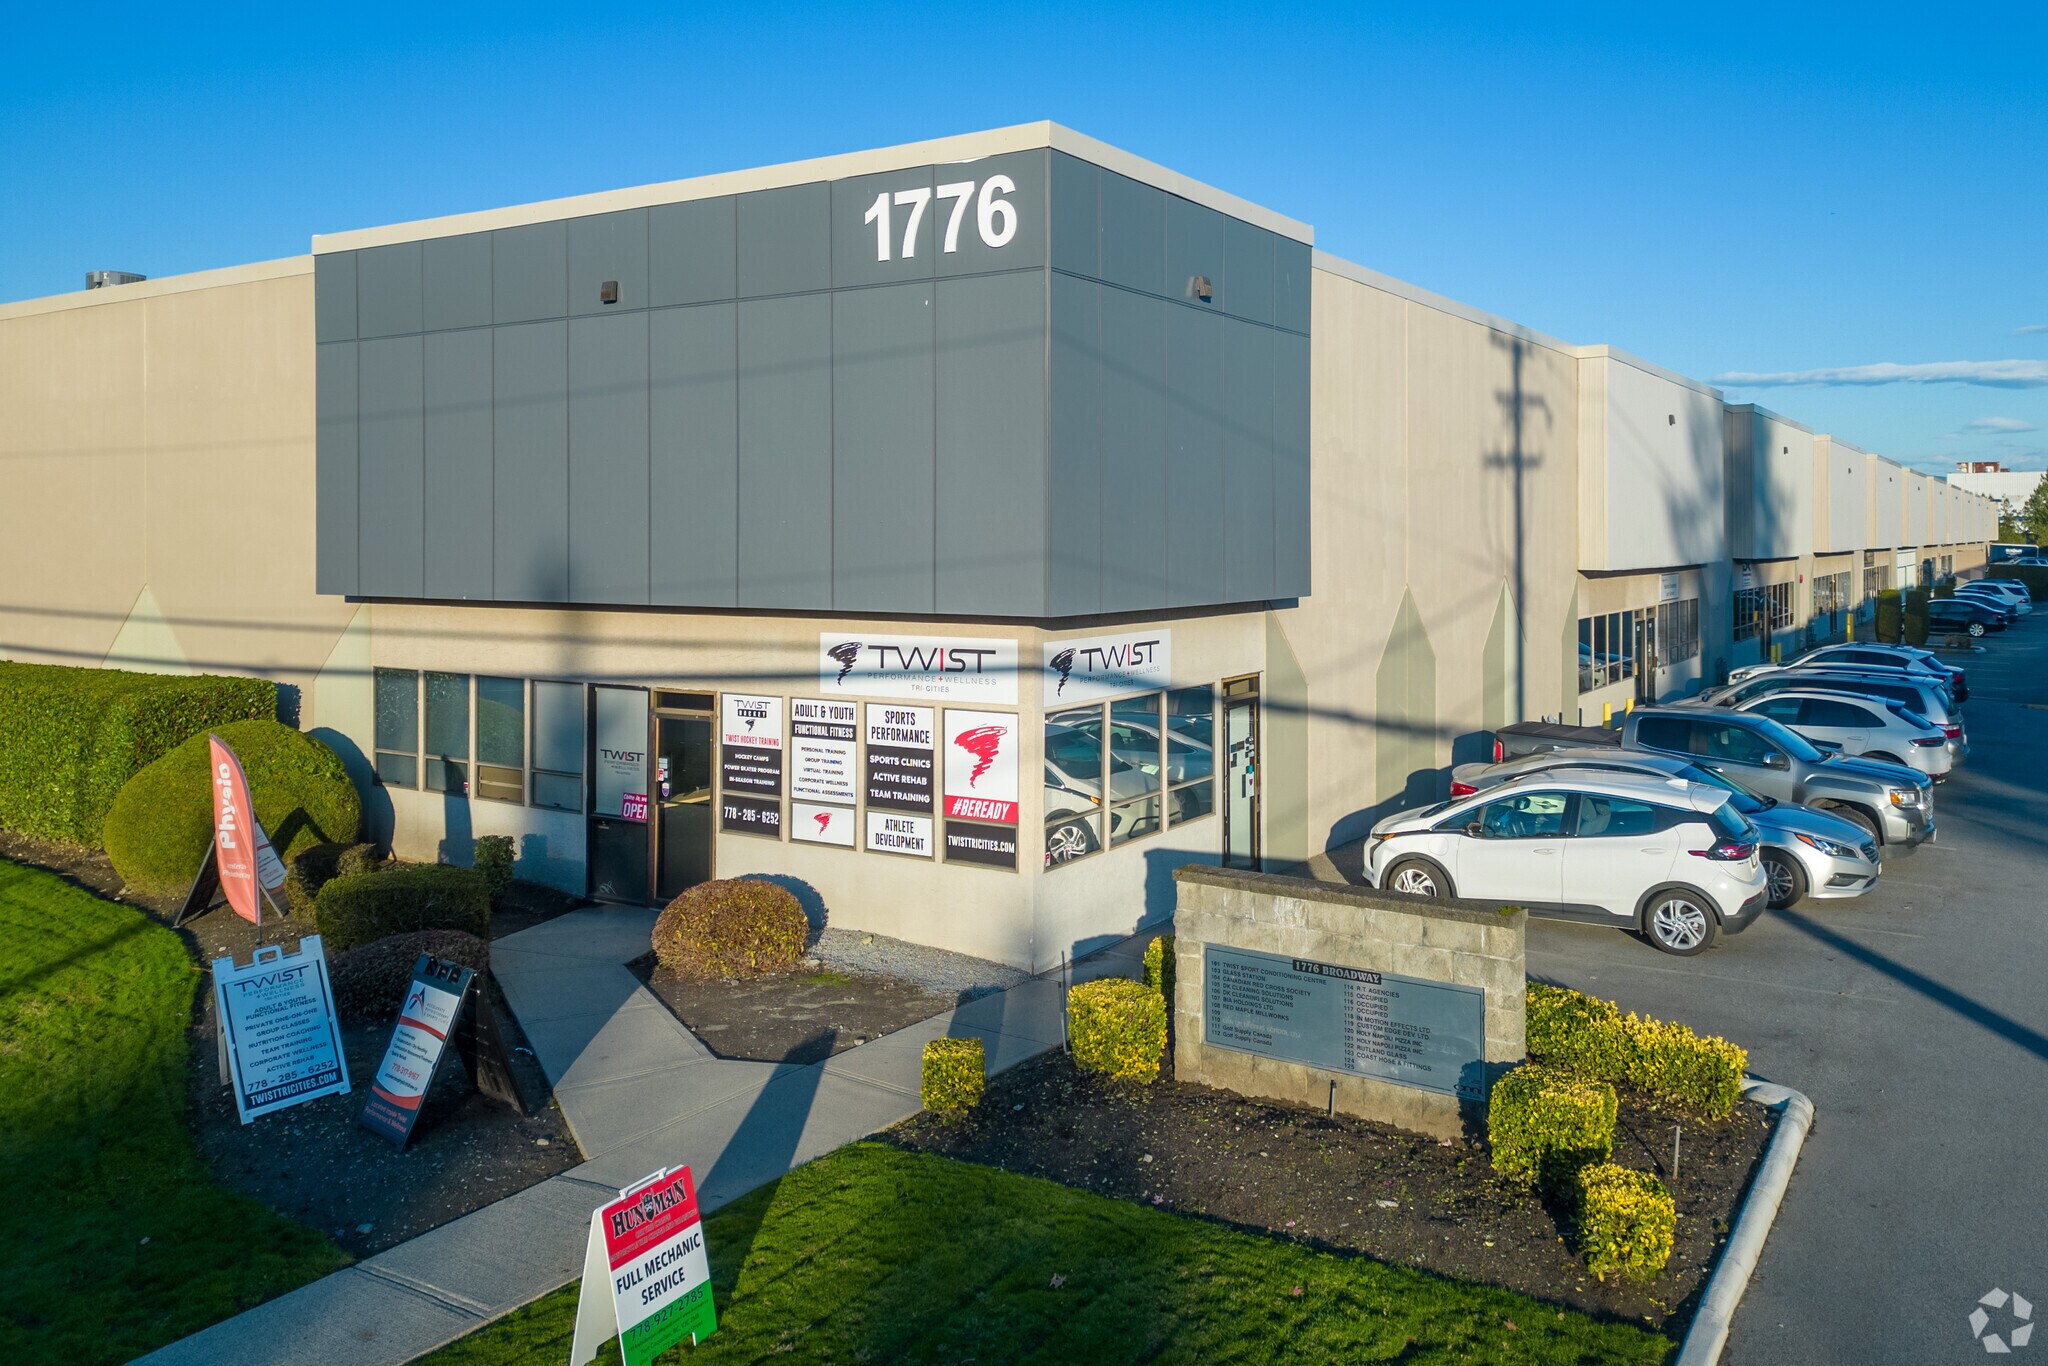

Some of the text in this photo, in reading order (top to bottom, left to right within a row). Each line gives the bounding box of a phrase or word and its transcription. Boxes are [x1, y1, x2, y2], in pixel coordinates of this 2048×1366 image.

[865, 174, 1017, 262] 1776
[868, 645, 996, 673] TWIST
[1080, 641, 1159, 672] TWIST
[868, 672, 936, 683] PERFORMANCE
[734, 700, 770, 710] TWIST
[795, 704, 854, 720] ADULT & YOUTH
[885, 710, 915, 726] SPORTS
[795, 724, 853, 738] FUNCTIONAL FITNESS
[872, 726, 930, 744] PERFORMANCE
[726, 734, 779, 746] TWIST HOCKEY TRAINING
[600, 749, 644, 762] TWIST
[869, 755, 930, 769] SPORTS CLINICS
[729, 776, 775, 787] IN-SEASON TRAINING
[873, 772, 927, 785] ACTIVE REHAB
[822, 790, 853, 798] ASSESSMENTS
[870, 789, 930, 803] TEAM TRAINING
[216, 762, 236, 849] Physio
[952, 798, 1010, 820] #BEREADY
[724, 806, 779, 825] 778 285 6252
[885, 818, 914, 834] ATHLETE
[875, 832, 924, 851] DEVELOPMENT
[948, 835, 1015, 853] TWISTTRICITIES.COM
[234, 965, 309, 992] TWIST
[1223, 969, 1241, 977] GLASS
[1242, 972, 1266, 981] STATION
[1261, 969, 1302, 980] CONDITIONING
[1303, 977, 1327, 985] CENTRE
[1295, 961, 1380, 984] 1776 BROADWAY
[243, 978, 304, 997] PERFORMANCE
[1223, 976, 1251, 986] CANADIAN
[1265, 984, 1285, 992] CROSS
[1286, 988, 1311, 996] SOCIETY
[1232, 985, 1260, 994] CLEANING
[1261, 990, 1294, 1000] SOLUTIONS
[1369, 988, 1400, 998] AGENCIES
[254, 995, 307, 1013] ADULT YOUTH
[1232, 992, 1260, 1001] CLEANING
[1261, 997, 1294, 1008] SOLUTIONS
[1233, 998, 1262, 1008] HOLDINGS
[1356, 994, 1388, 1003] OCCUPIED
[1356, 1001, 1388, 1011] OCCUPIED
[246, 998, 316, 1021] FUNCTIONAL FITNESS
[1235, 1006, 1254, 1014] MAPLE
[1255, 1010, 1289, 1021] MILLWORKS
[1356, 1008, 1388, 1018] OCCUPIED
[245, 1008, 318, 1032] PRIVATE ONE-ON-ONE
[256, 1018, 310, 1037] GROUP CLASSES
[1364, 1017, 1389, 1026] MOTION
[1390, 1022, 1418, 1032] EFFECTS
[248, 1024, 321, 1049] NUTRITION COACHING
[1234, 1027, 1251, 1036] Supply
[1253, 1030, 1272, 1039] Canada
[1357, 1022, 1383, 1032] CUSTOM
[1384, 1027, 1401, 1035] EDGE
[261, 1036, 312, 1055] TEAM TRAINING
[1234, 1034, 1251, 1043] Supply
[1253, 1038, 1272, 1046] Canada
[1356, 1030, 1371, 1038] HOLY
[1372, 1032, 1394, 1042] NAPOLI
[1395, 1037, 1411, 1046] PIZZA
[1356, 1037, 1371, 1046] HOLY
[1372, 1040, 1394, 1050] NAPOLI
[1395, 1044, 1411, 1053] PIZZA
[250, 1041, 327, 1068] CORPORATE WELLNESS
[1356, 1045, 1385, 1056] RUTLAND
[1386, 1050, 1407, 1060] GLASS
[1356, 1052, 1377, 1060] COAST
[1379, 1056, 1396, 1065] HOSE
[266, 1055, 314, 1073] ACTIVE REHAB
[248, 1060, 334, 1092] 778 285 6252
[250, 1072, 337, 1106] TWISTTRICITIES.COM
[616, 1268, 643, 1294] FULL
[645, 1232, 701, 1278] MECHANIC
[641, 1266, 685, 1306] SERVICE
[630, 1288, 703, 1341] 778-927-2785
